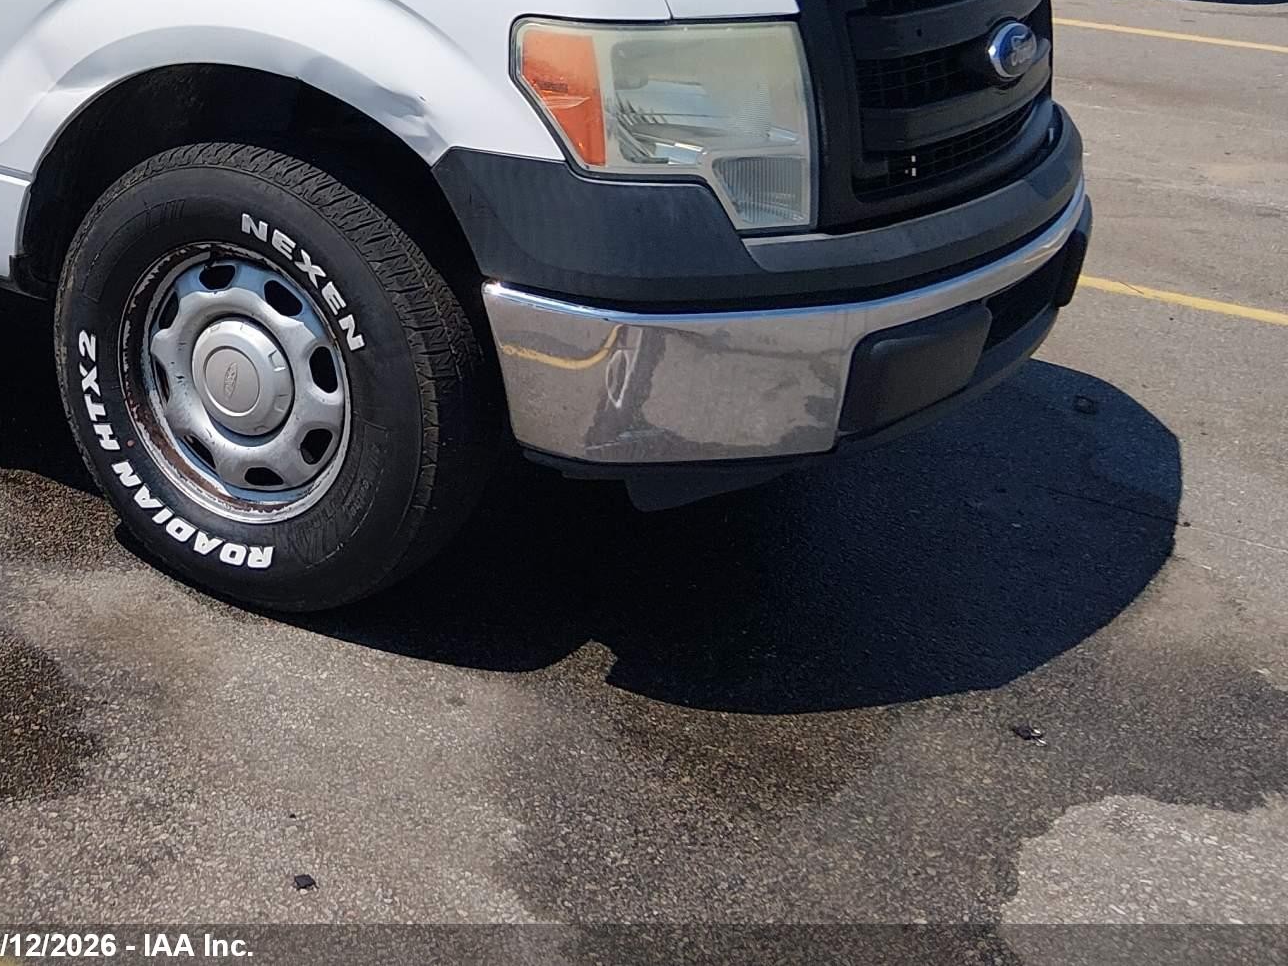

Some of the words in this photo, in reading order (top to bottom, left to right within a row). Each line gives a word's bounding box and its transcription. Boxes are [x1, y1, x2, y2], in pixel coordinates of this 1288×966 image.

[240, 212, 367, 352] NEXEN
[77, 328, 121, 452] HTX2
[111, 461, 274, 569] ROADIAN
